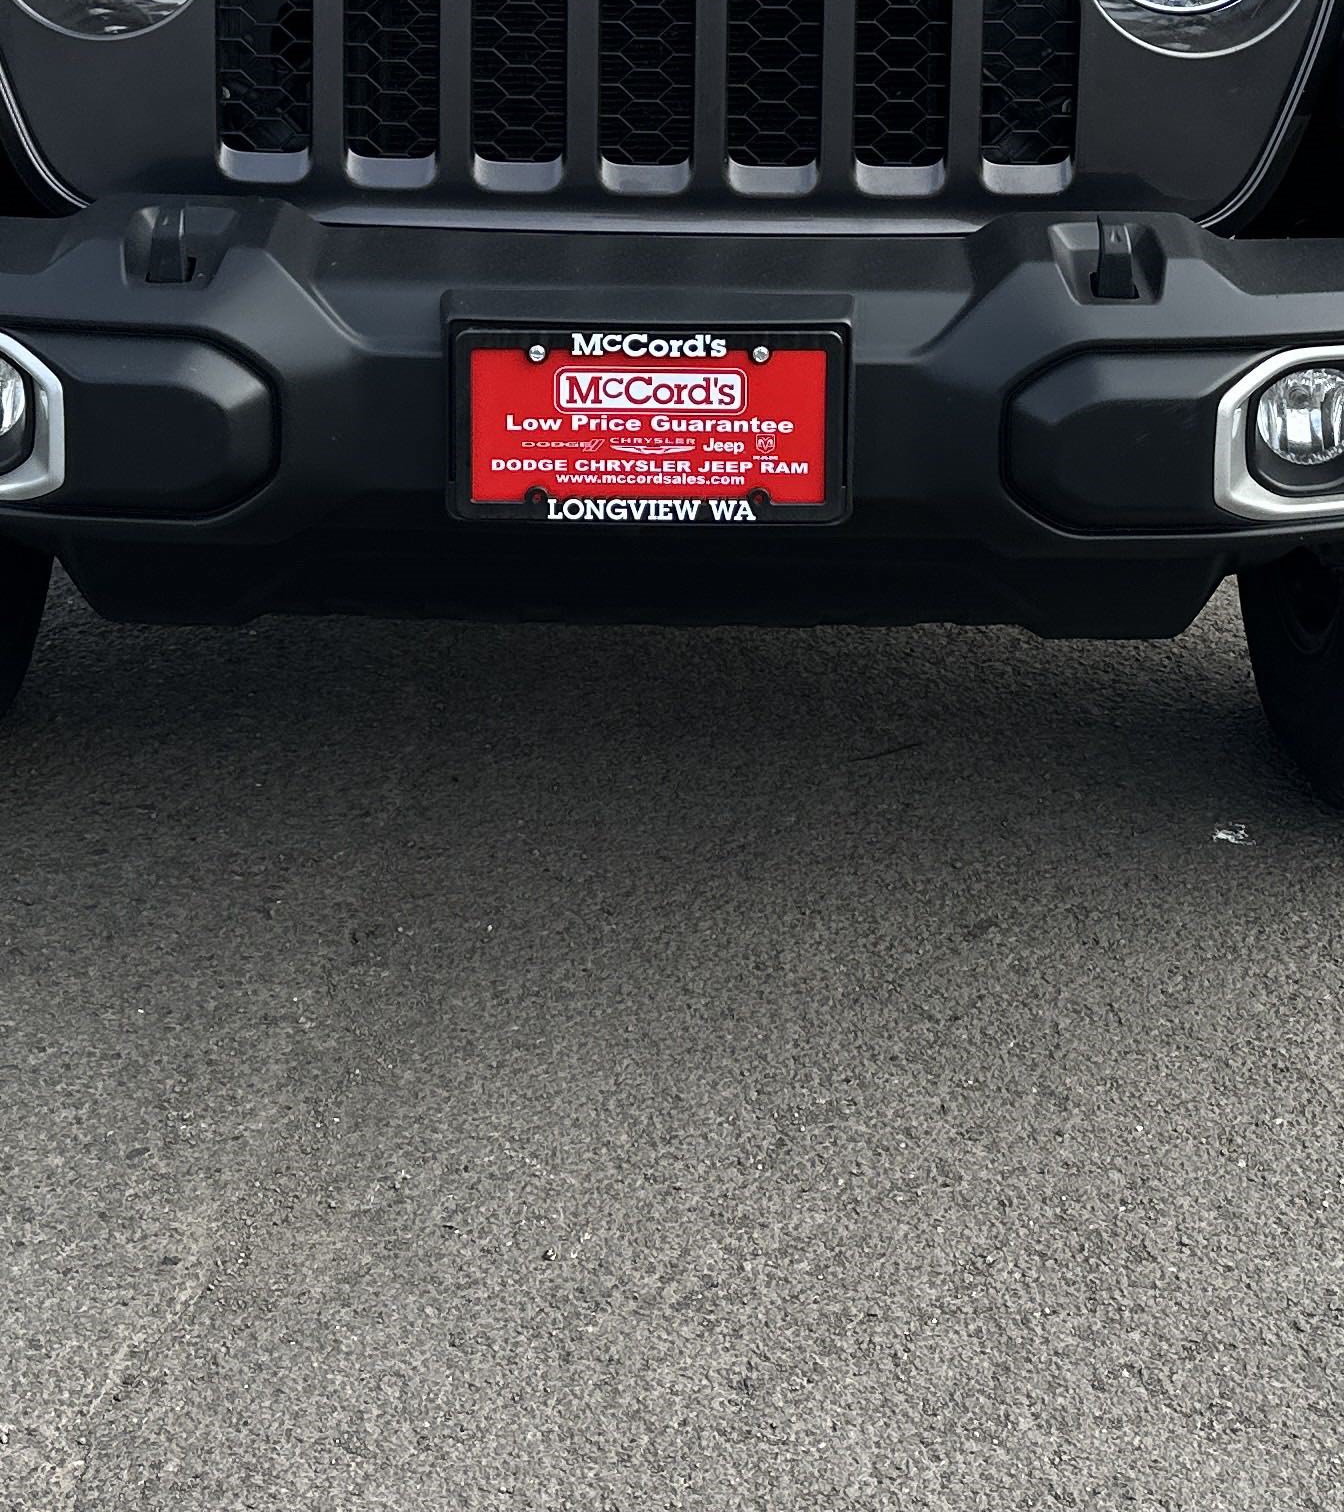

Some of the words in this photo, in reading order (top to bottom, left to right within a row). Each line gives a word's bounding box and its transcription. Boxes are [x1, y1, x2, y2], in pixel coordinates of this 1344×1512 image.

[571, 333, 727, 357] McCord's
[565, 375, 736, 406] McCord's
[506, 414, 562, 431] Low
[571, 414, 642, 432] Price
[650, 415, 794, 434] Guarantee
[609, 437, 697, 445] CHRYSLER
[703, 438, 745, 454] Jeep
[491, 459, 568, 472] DODGE
[574, 459, 692, 473] CHRYSLER
[697, 461, 753, 473] JEEP
[760, 461, 809, 475] RAM
[556, 473, 745, 486] www.mccordsales.com
[547, 498, 701, 520] LONGVIEW
[708, 499, 757, 521] WA
